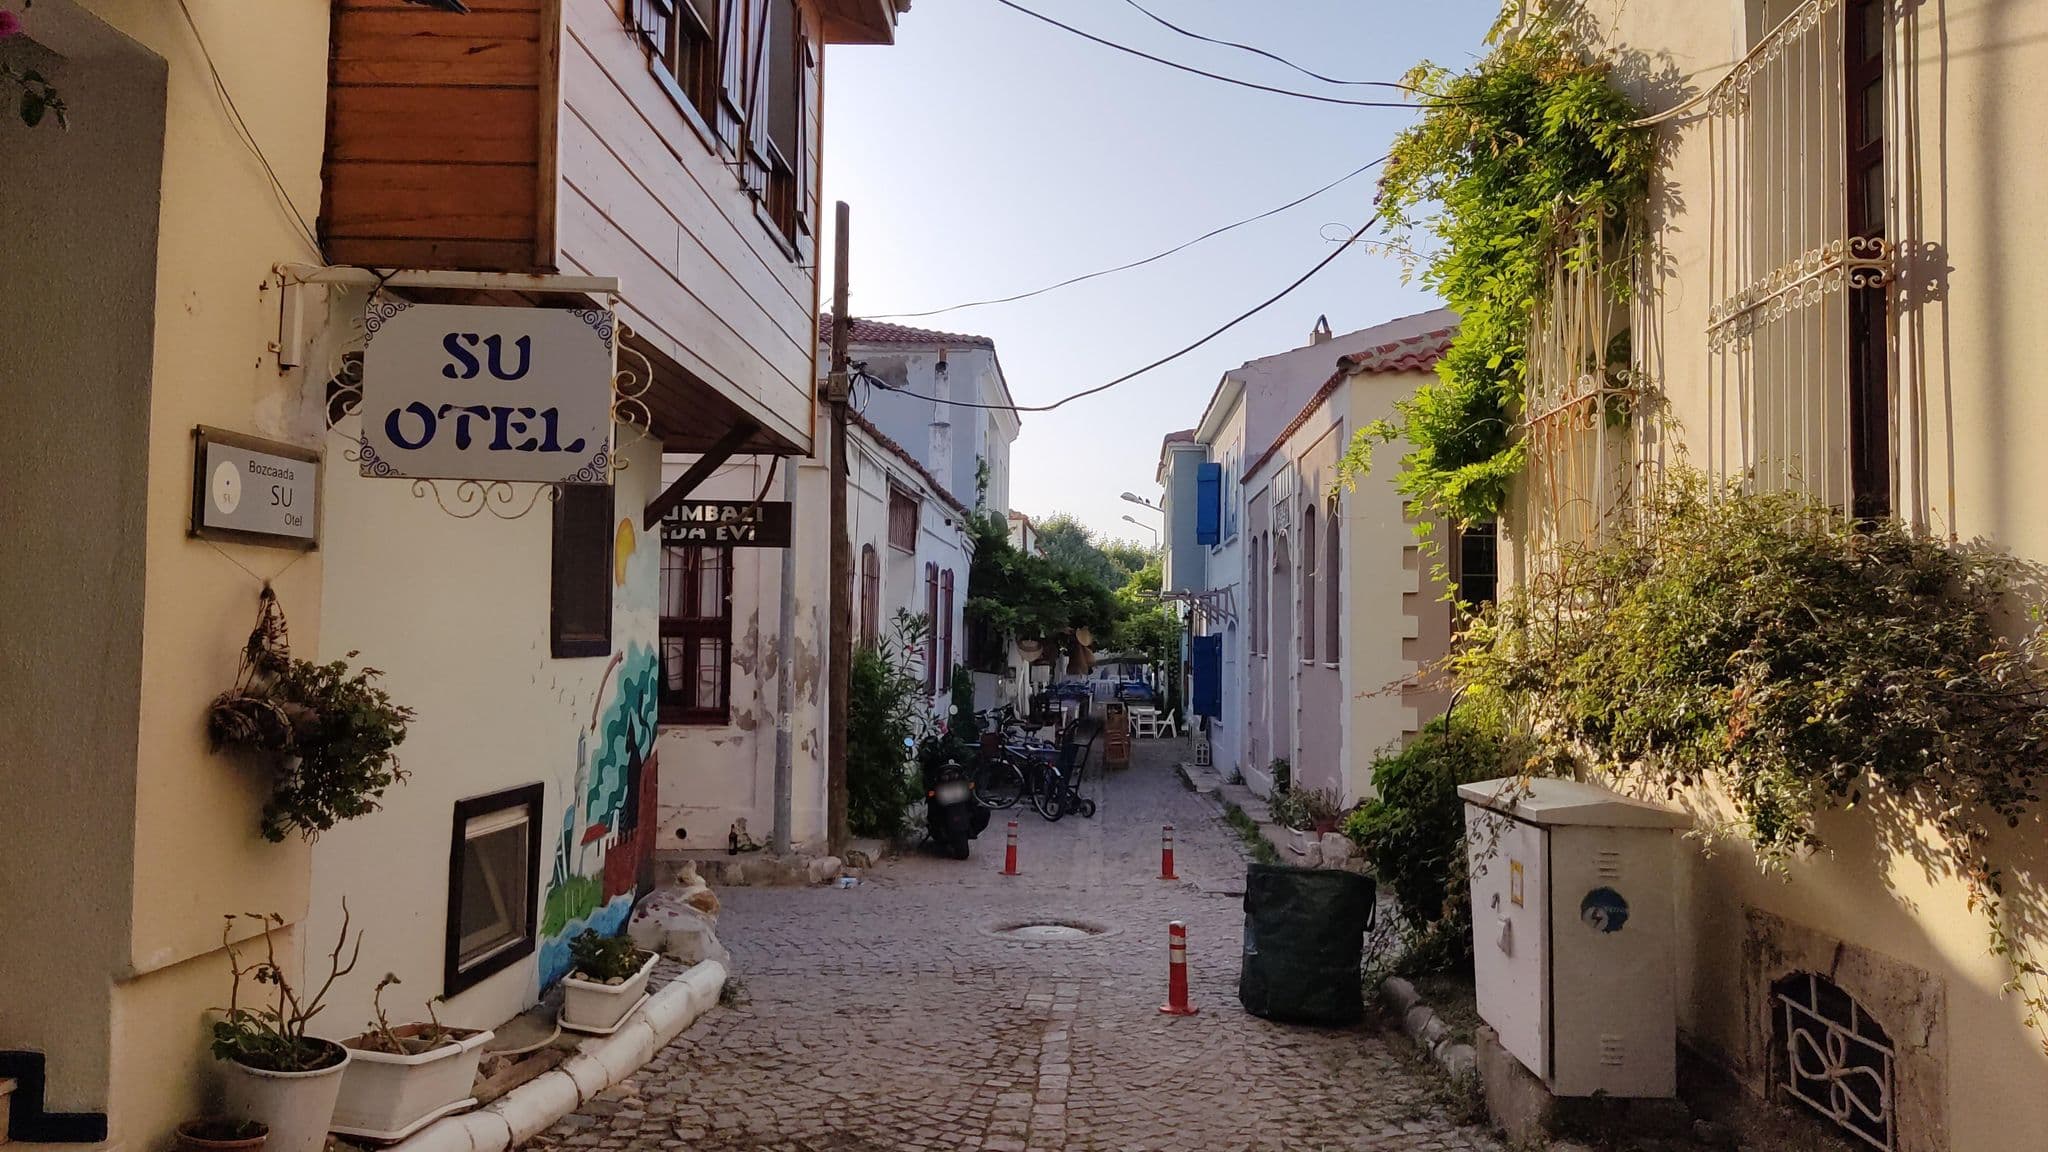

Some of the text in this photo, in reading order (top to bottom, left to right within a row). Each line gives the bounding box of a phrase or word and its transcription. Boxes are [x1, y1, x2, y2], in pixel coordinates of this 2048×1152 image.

[442, 332, 531, 381] SU
[385, 401, 586, 453] OTEL
[249, 460, 294, 480] Bozcaada
[271, 485, 293, 507] SU
[284, 513, 302, 526] Otel
